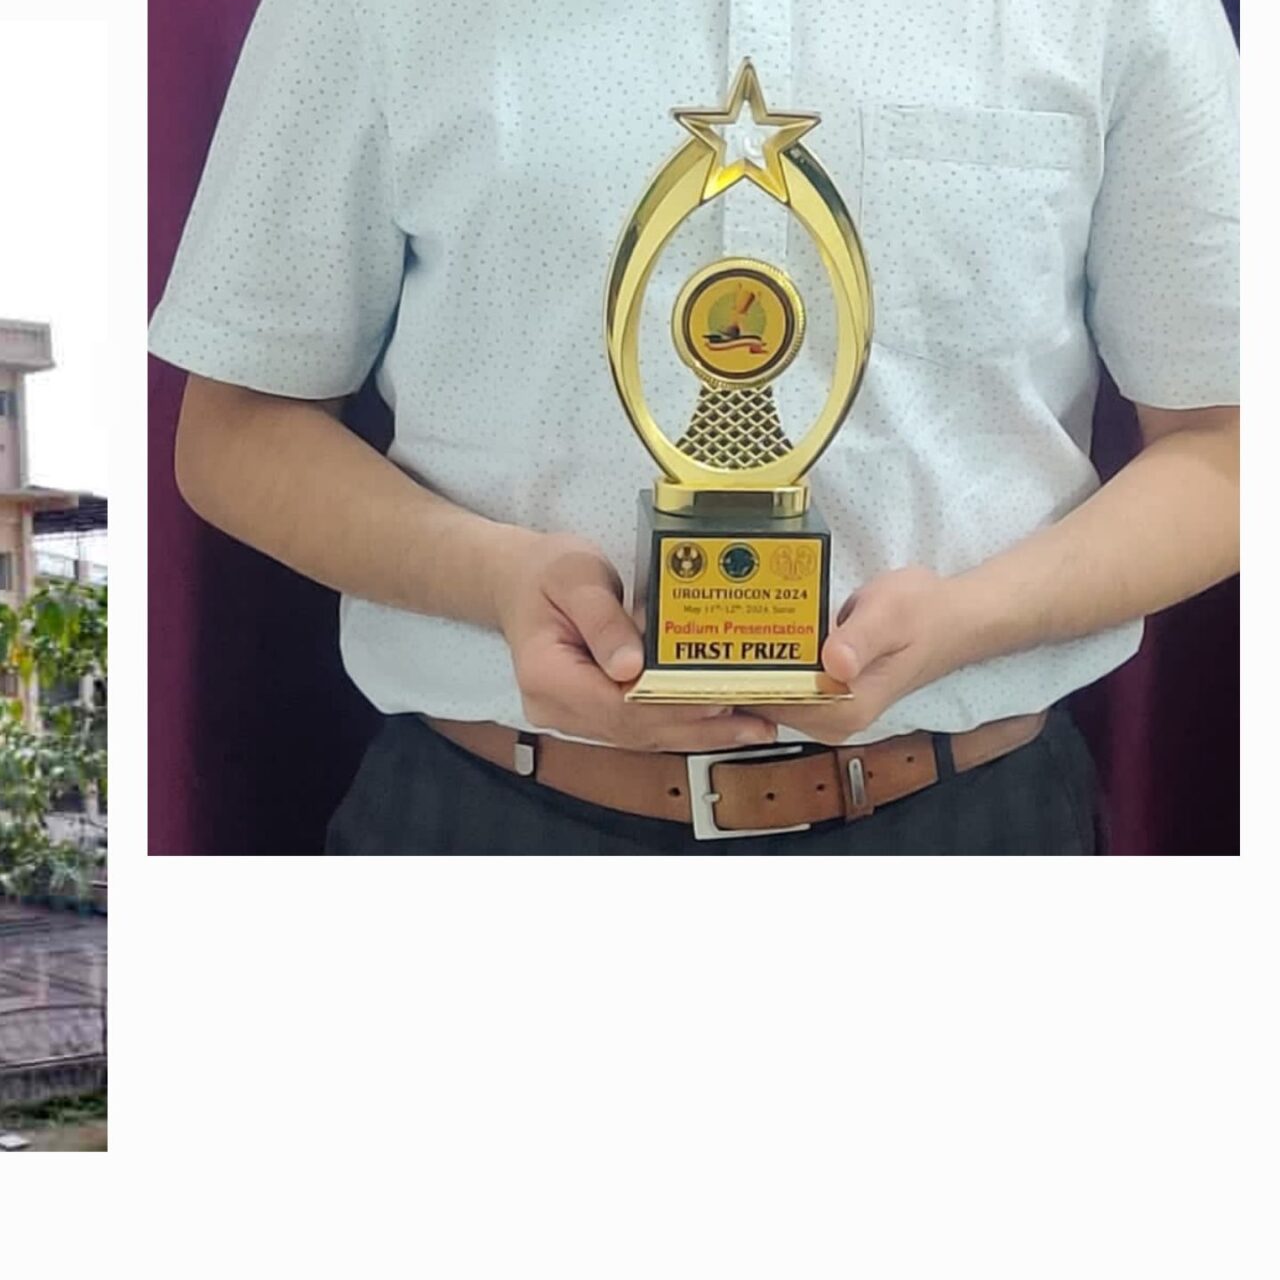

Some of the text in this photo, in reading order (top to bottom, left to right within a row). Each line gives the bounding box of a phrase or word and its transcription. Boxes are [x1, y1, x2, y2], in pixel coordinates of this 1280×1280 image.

[673, 588, 808, 600] UROLITHOCON 2024
[665, 620, 814, 635] Podium Presentation
[675, 641, 801, 660] FIRST PRIZE
